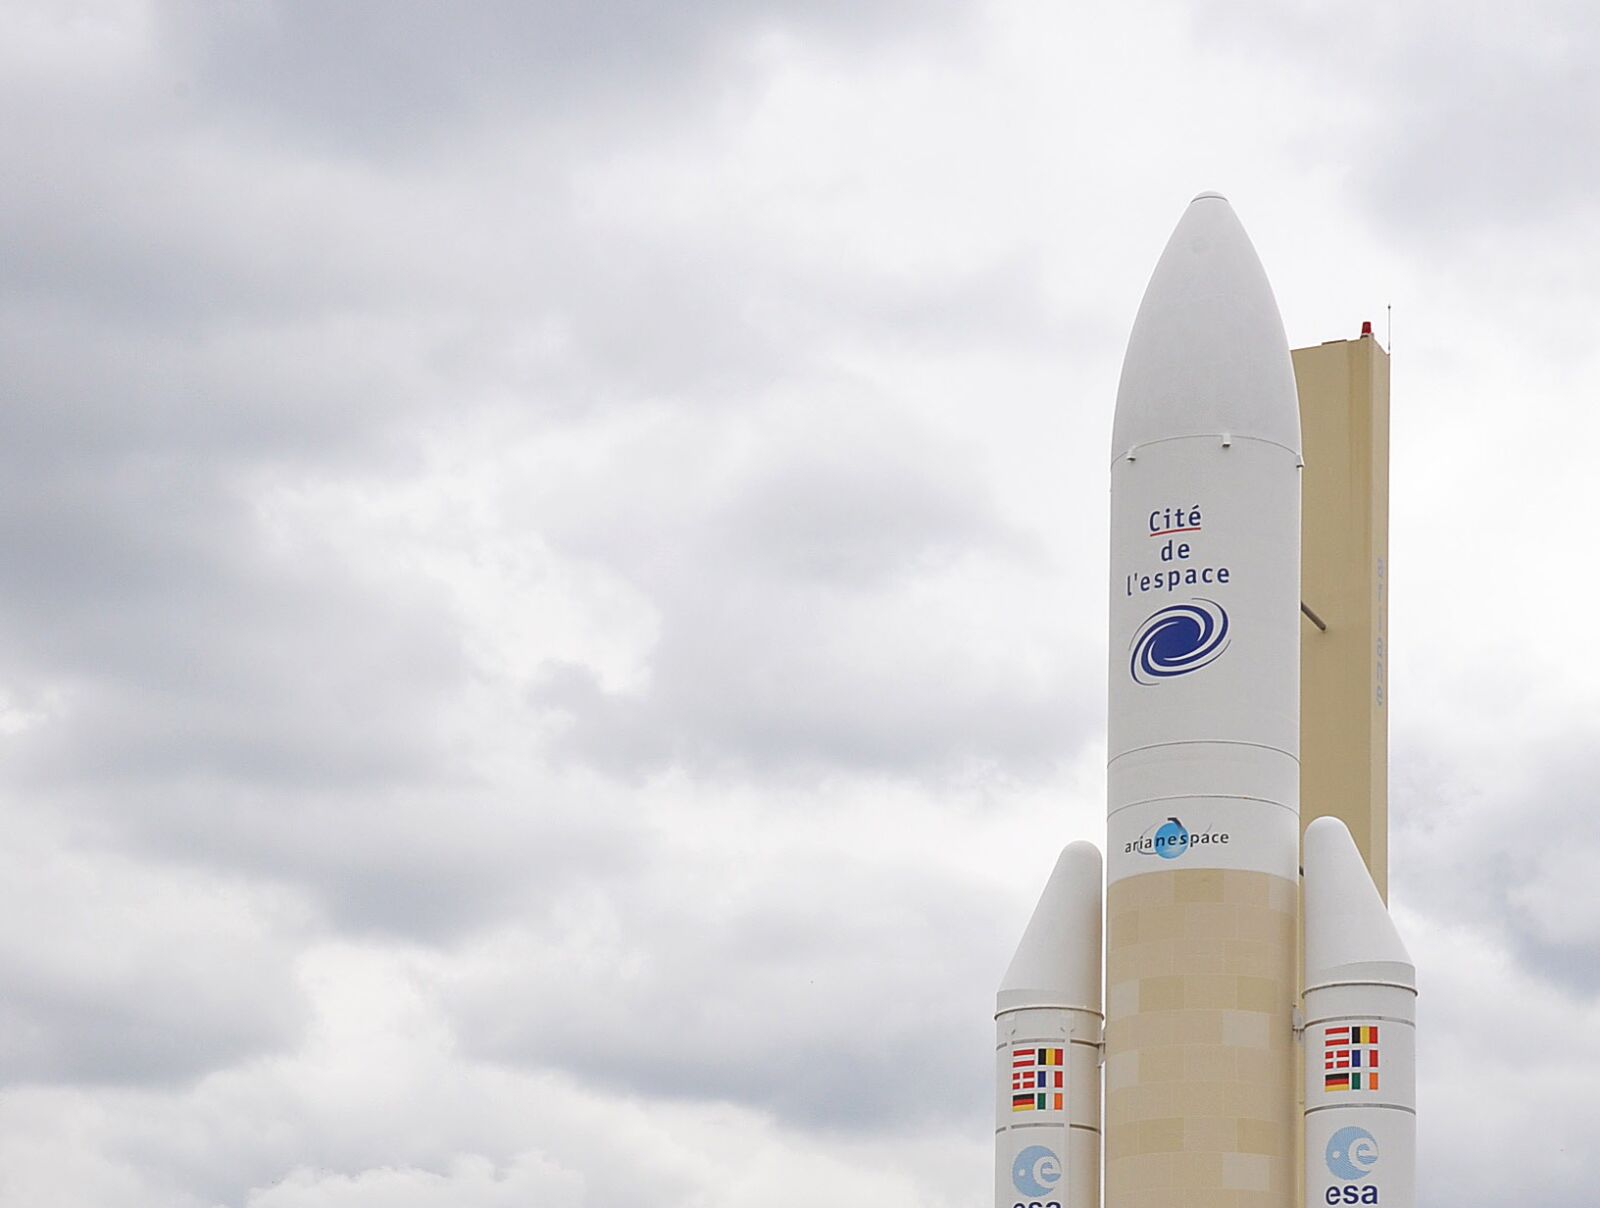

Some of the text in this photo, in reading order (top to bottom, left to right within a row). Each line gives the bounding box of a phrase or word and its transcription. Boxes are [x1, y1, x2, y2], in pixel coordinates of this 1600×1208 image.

[1149, 504, 1201, 532] Cité
[1161, 540, 1190, 561] de
[1127, 567, 1230, 596] l'espace
[1125, 833, 1229, 853] arianespace
[1325, 1184, 1378, 1206] esa
